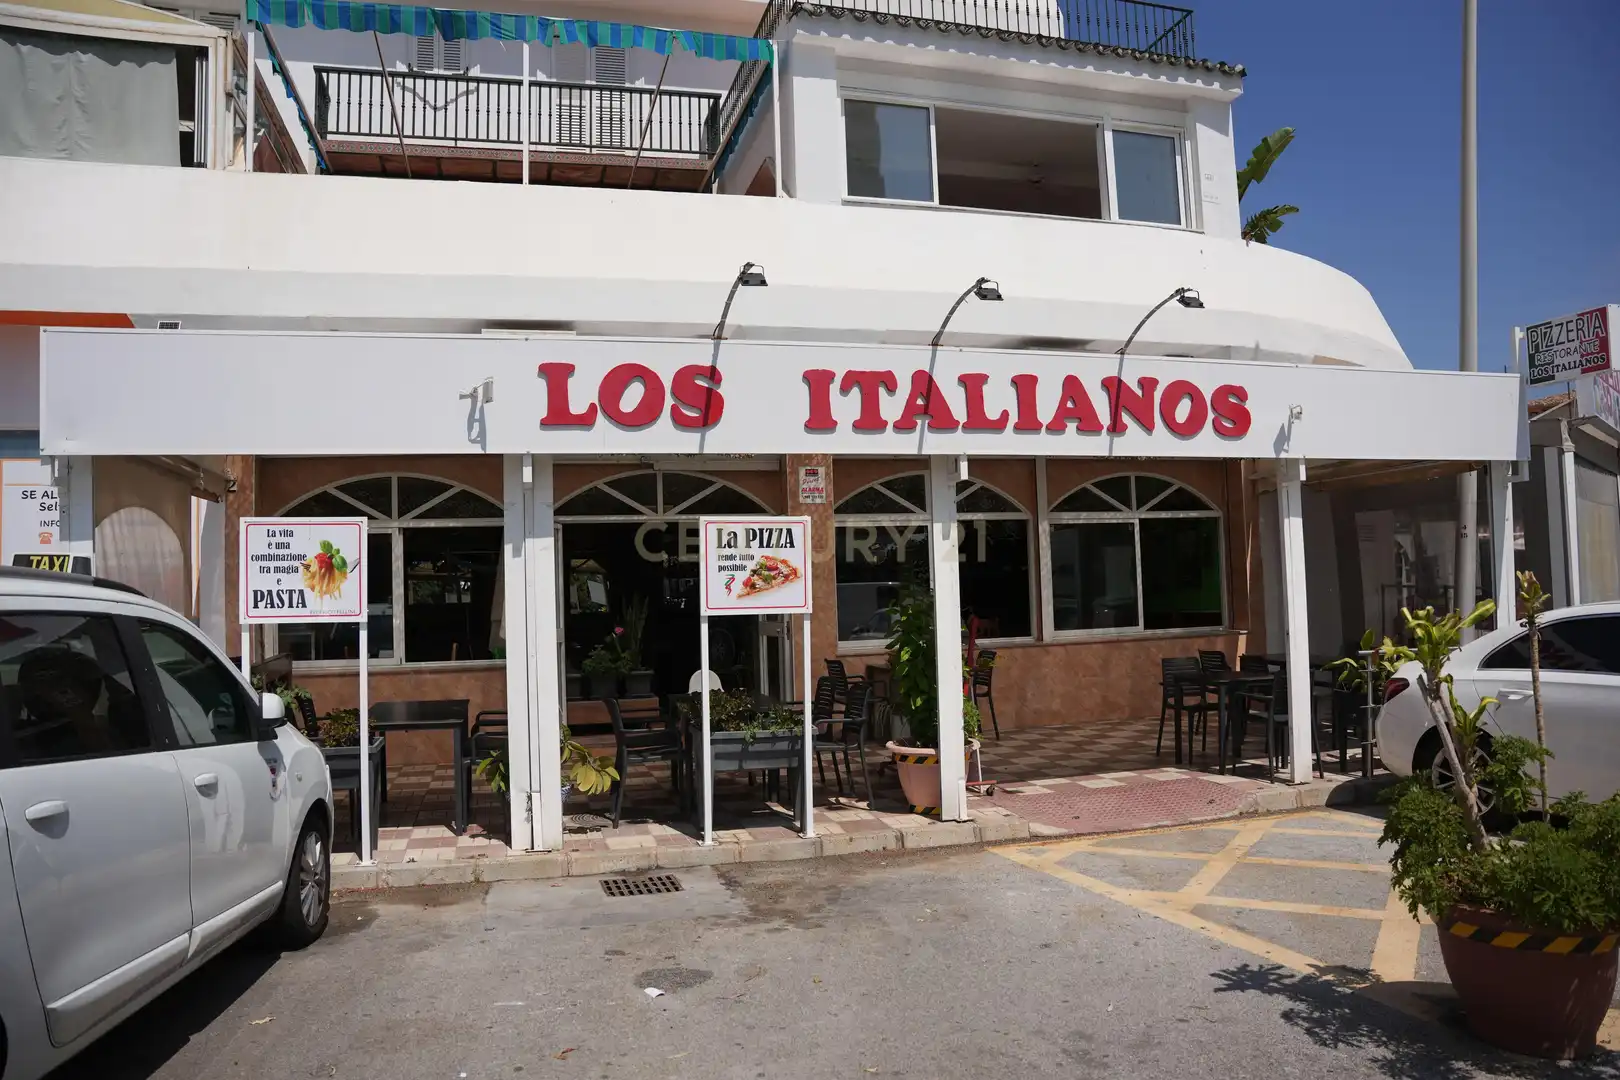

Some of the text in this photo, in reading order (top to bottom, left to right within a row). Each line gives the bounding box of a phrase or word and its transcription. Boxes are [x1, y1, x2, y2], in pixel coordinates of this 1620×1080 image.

[1529, 312, 1605, 353] PIZZERIA
[1530, 354, 1606, 379] LOS ITALIANOS
[538, 362, 1252, 438] LOS ITALIANOS
[21, 490, 60, 500] SE AL
[39, 501, 60, 512] Sel
[266, 528, 294, 538] La vita
[716, 527, 795, 549] La PIZZA
[267, 540, 291, 550] è una
[250, 552, 308, 562] combinazione
[717, 553, 755, 562] rende tutto
[30, 556, 69, 573] TAXI
[259, 564, 299, 575] tra magia
[717, 563, 748, 573] possibile
[276, 577, 282, 586] e
[252, 588, 308, 609] PASTA
